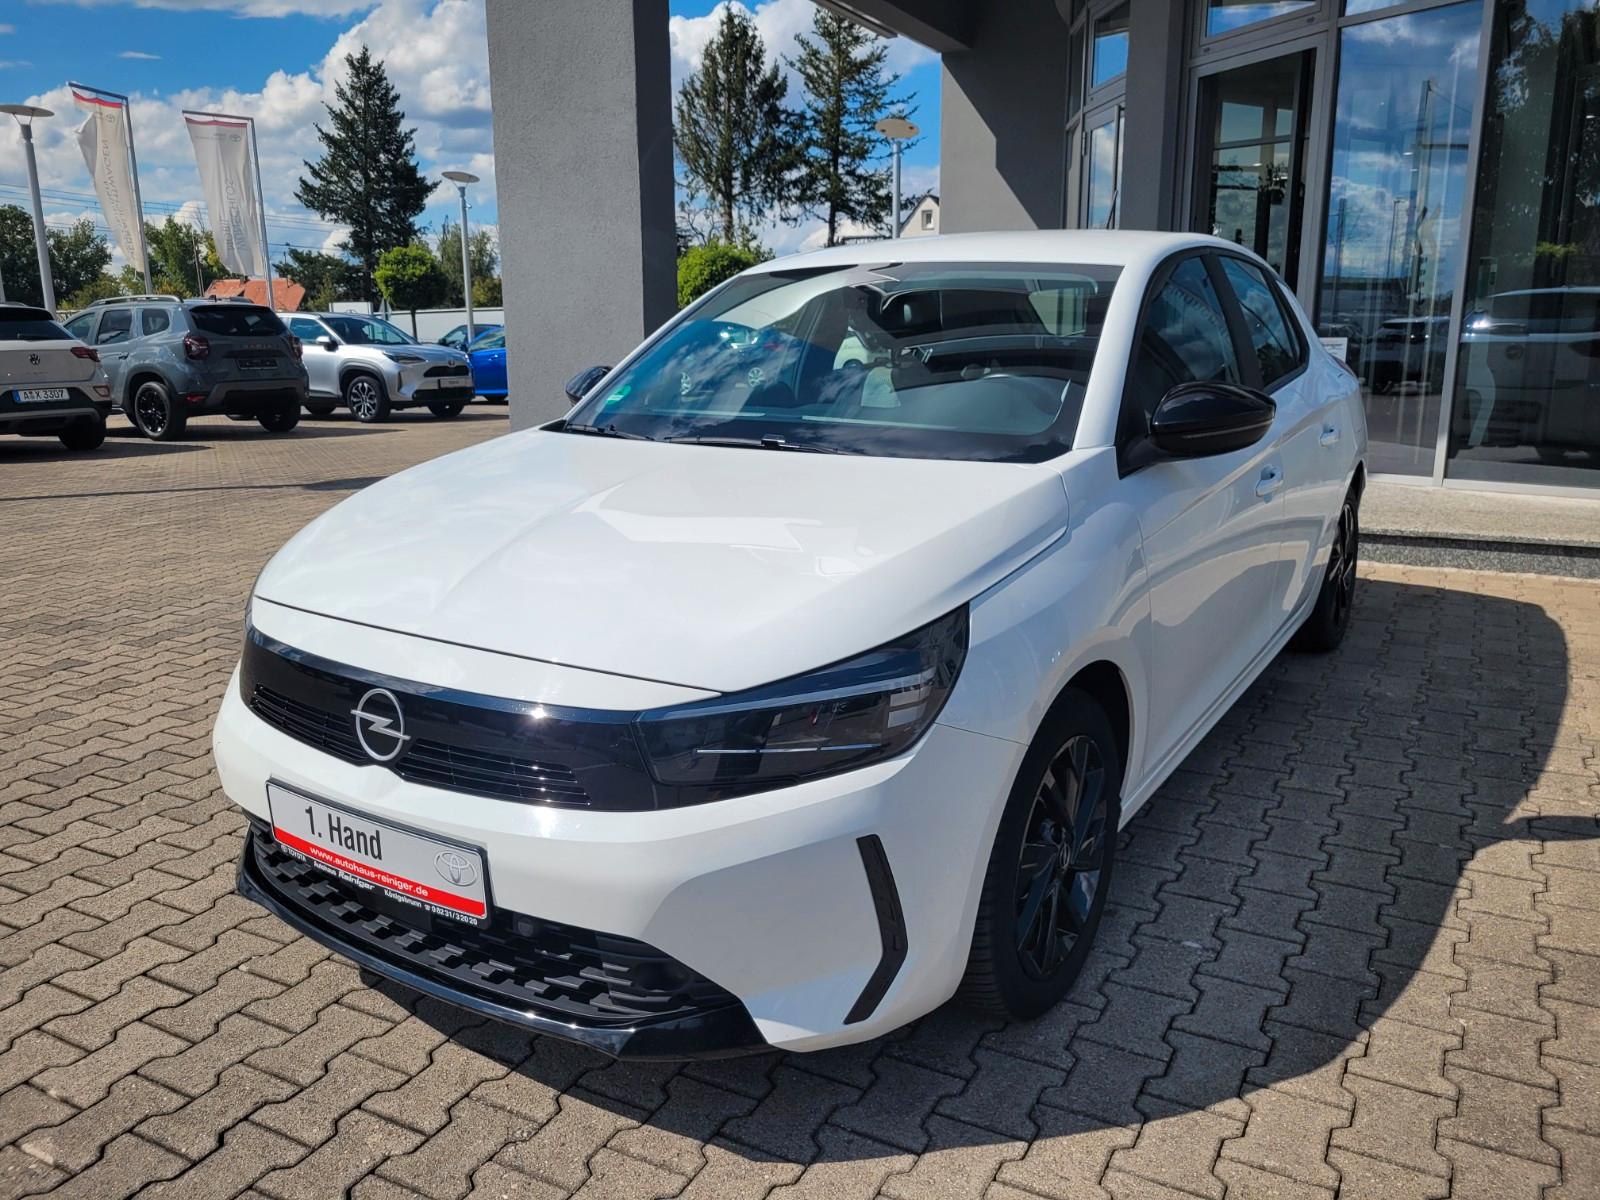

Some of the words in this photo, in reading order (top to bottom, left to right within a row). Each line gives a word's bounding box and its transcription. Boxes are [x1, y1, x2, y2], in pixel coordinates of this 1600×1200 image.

[23, 391, 29, 400] A
[36, 391, 41, 399] X
[43, 389, 64, 400] 3307
[304, 805, 323, 839] 1.
[328, 813, 383, 861] Hand
[309, 847, 429, 897] www.autohaus-reiniger.de
[338, 870, 376, 890] Reiniger
